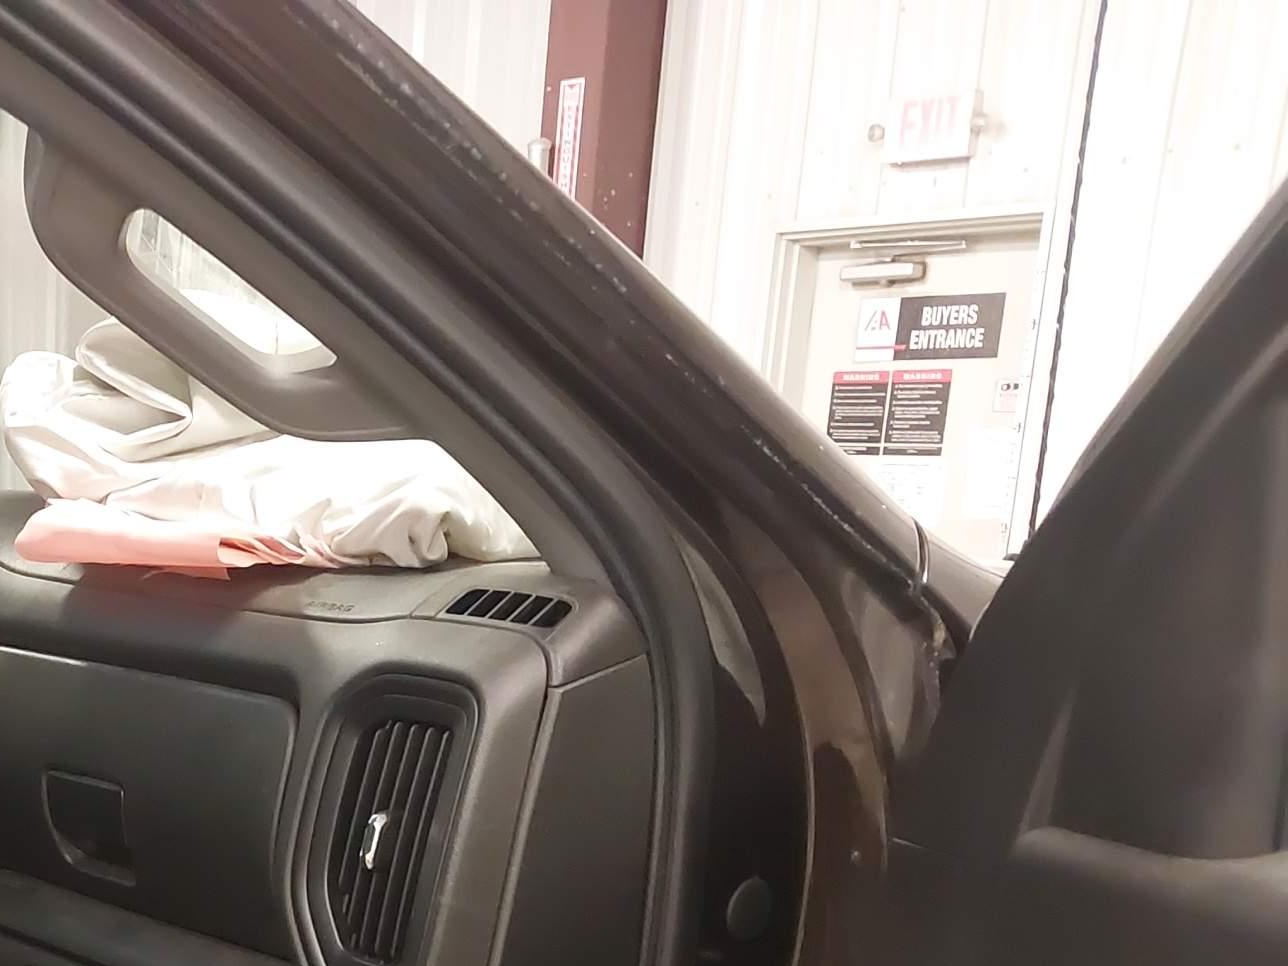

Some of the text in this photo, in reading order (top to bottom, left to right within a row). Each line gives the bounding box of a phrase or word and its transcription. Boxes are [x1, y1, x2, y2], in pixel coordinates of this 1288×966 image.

[898, 95, 959, 146] EXIT
[921, 304, 979, 326] BUYERS
[909, 327, 985, 350] ENTRANCE
